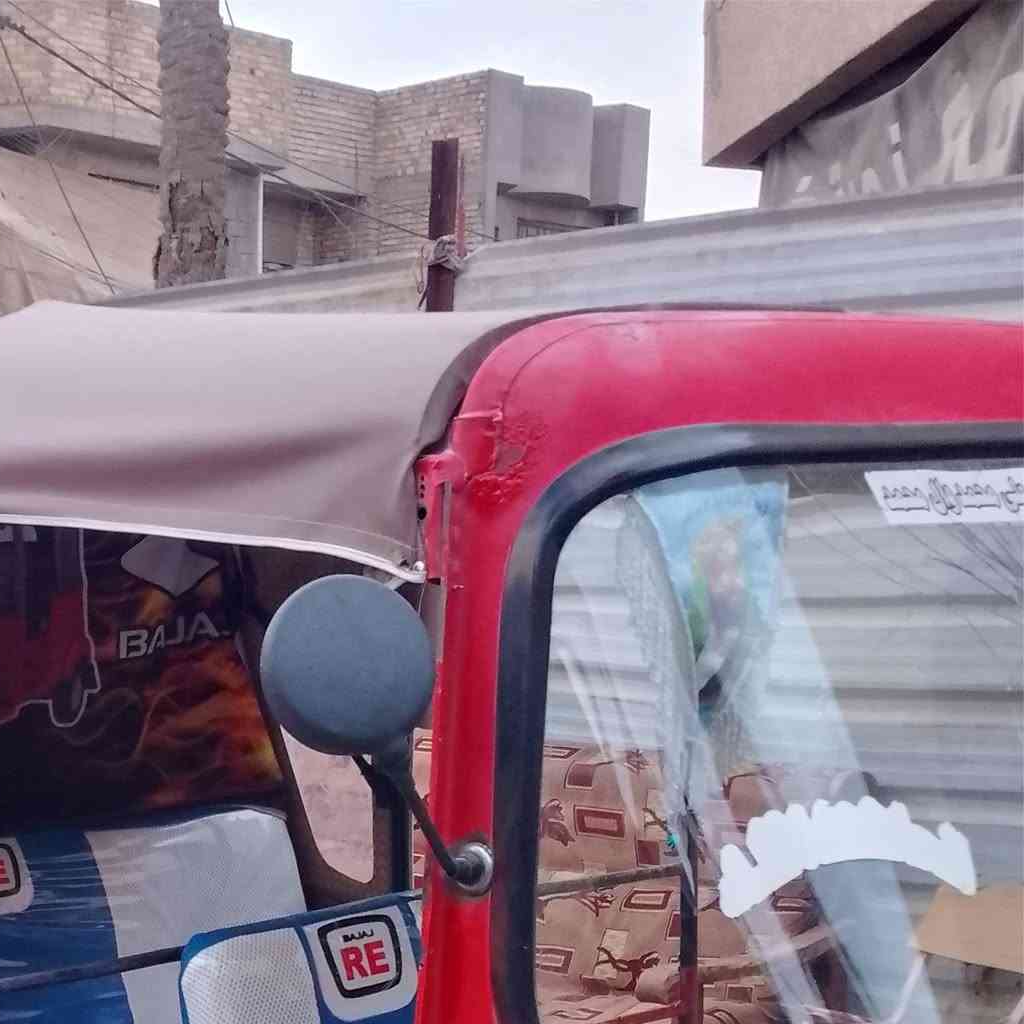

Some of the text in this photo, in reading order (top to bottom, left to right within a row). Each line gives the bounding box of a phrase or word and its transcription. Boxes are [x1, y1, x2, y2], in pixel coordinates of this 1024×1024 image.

[120, 611, 231, 659] BAJA
[342, 929, 374, 942] BAJAJ
[339, 939, 390, 981] RE
